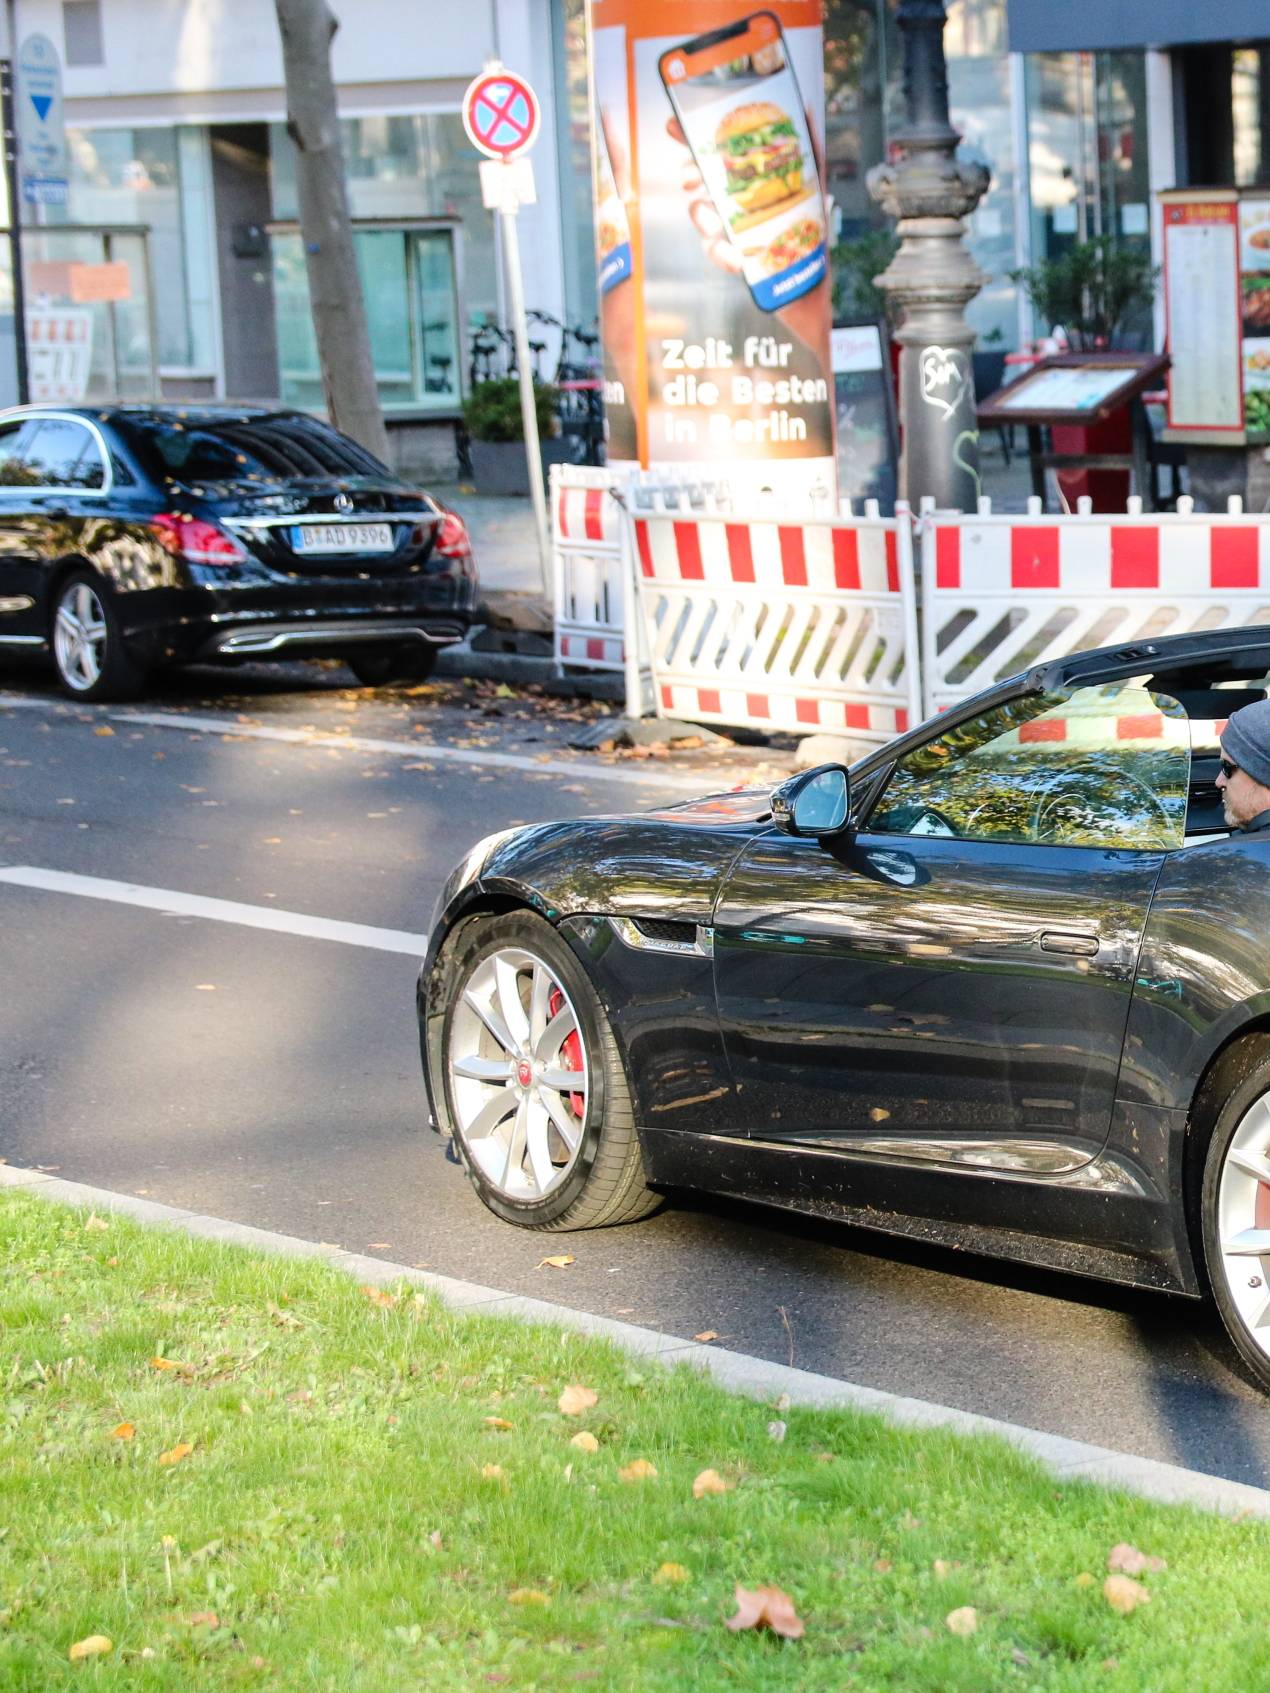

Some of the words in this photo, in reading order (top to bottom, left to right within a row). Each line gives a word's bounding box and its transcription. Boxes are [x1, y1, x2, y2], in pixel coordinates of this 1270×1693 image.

[662, 337, 734, 369] Zeit
[744, 336, 793, 367] für
[662, 374, 719, 405] die
[731, 375, 828, 404] Besten
[664, 412, 697, 443] in
[709, 410, 807, 443] Berlin
[302, 529, 314, 546] B
[325, 529, 346, 545] AD
